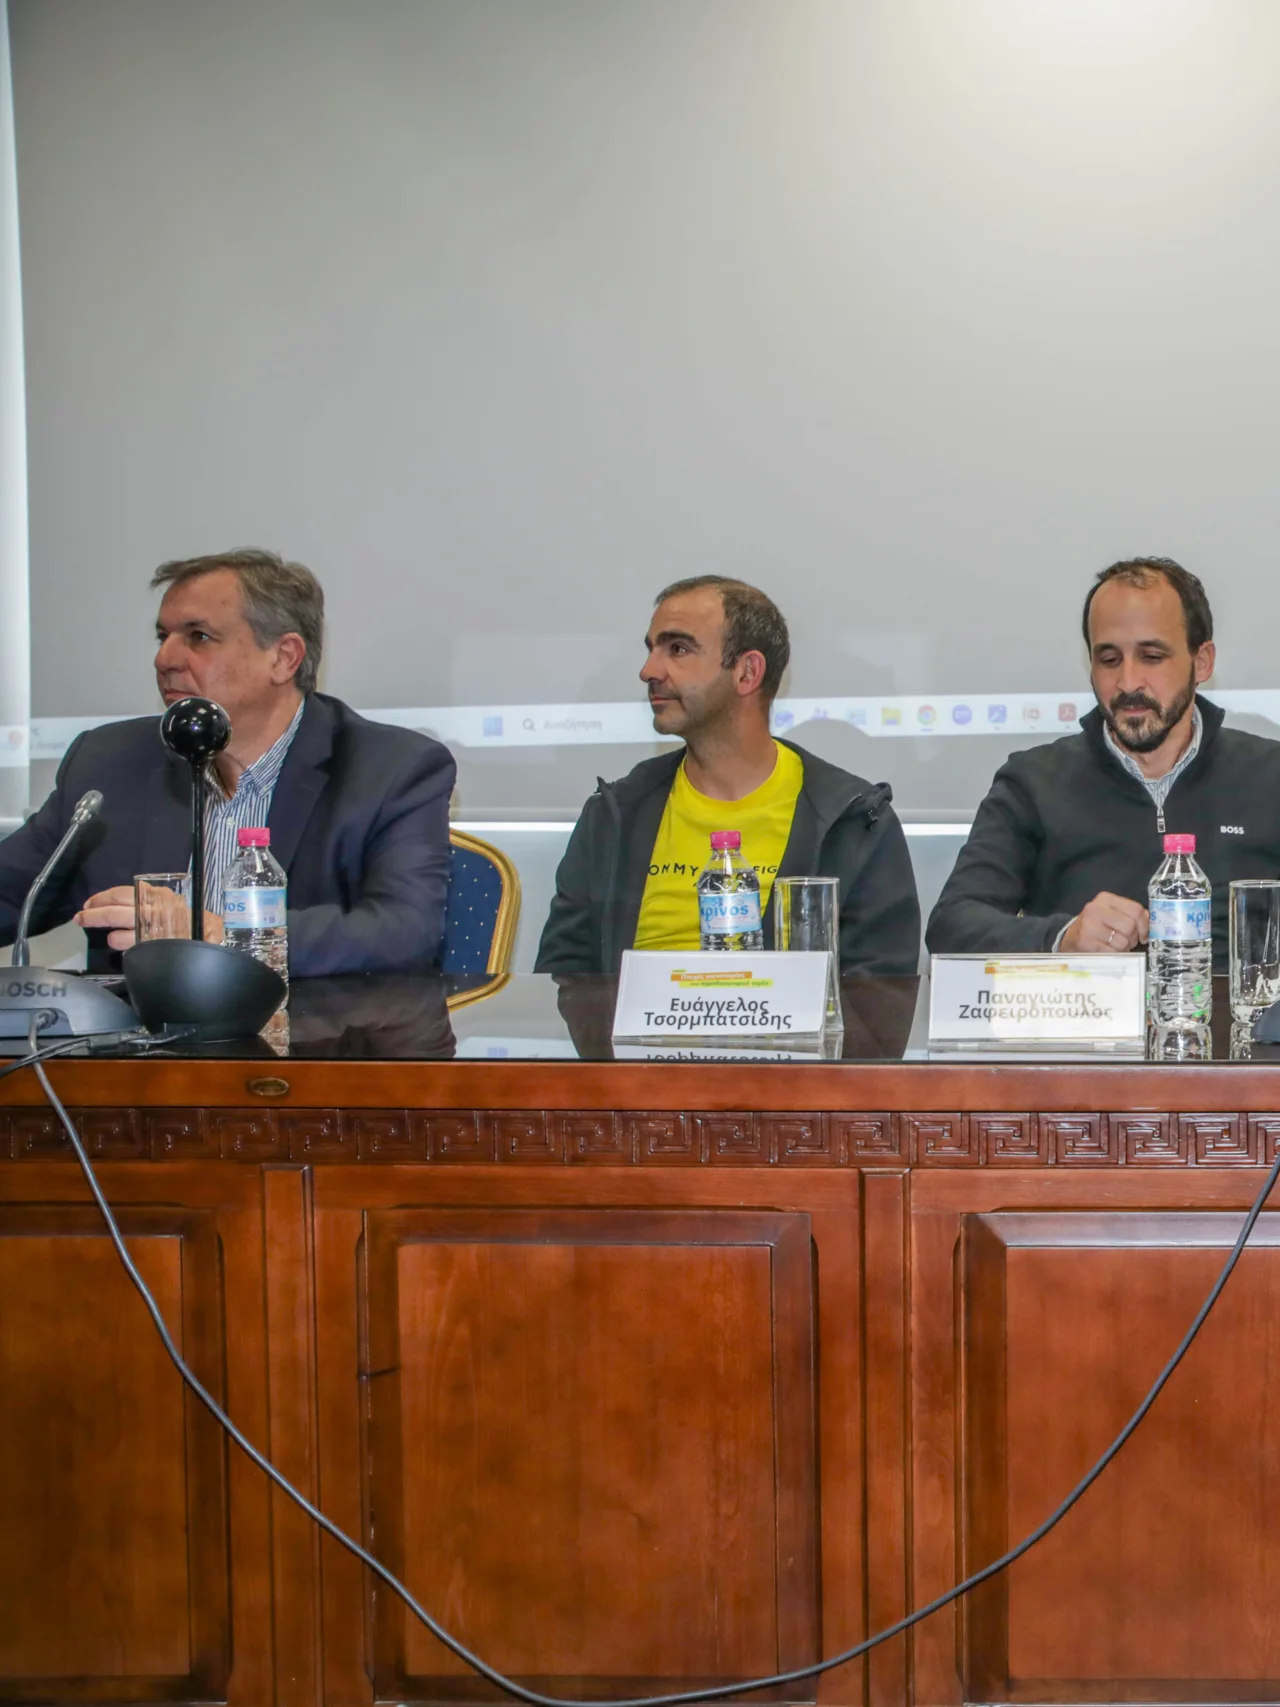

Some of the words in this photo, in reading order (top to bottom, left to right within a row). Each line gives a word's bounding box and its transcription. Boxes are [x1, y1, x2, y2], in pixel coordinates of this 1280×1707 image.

[1220, 825, 1245, 835] BOSS
[670, 996, 770, 1015] Ευάγγελος
[977, 989, 1097, 1008] Παναγιώτης
[644, 1010, 793, 1030] Τσορμπατσίδης
[958, 1003, 1114, 1023] Ζαφειρόπουλος
